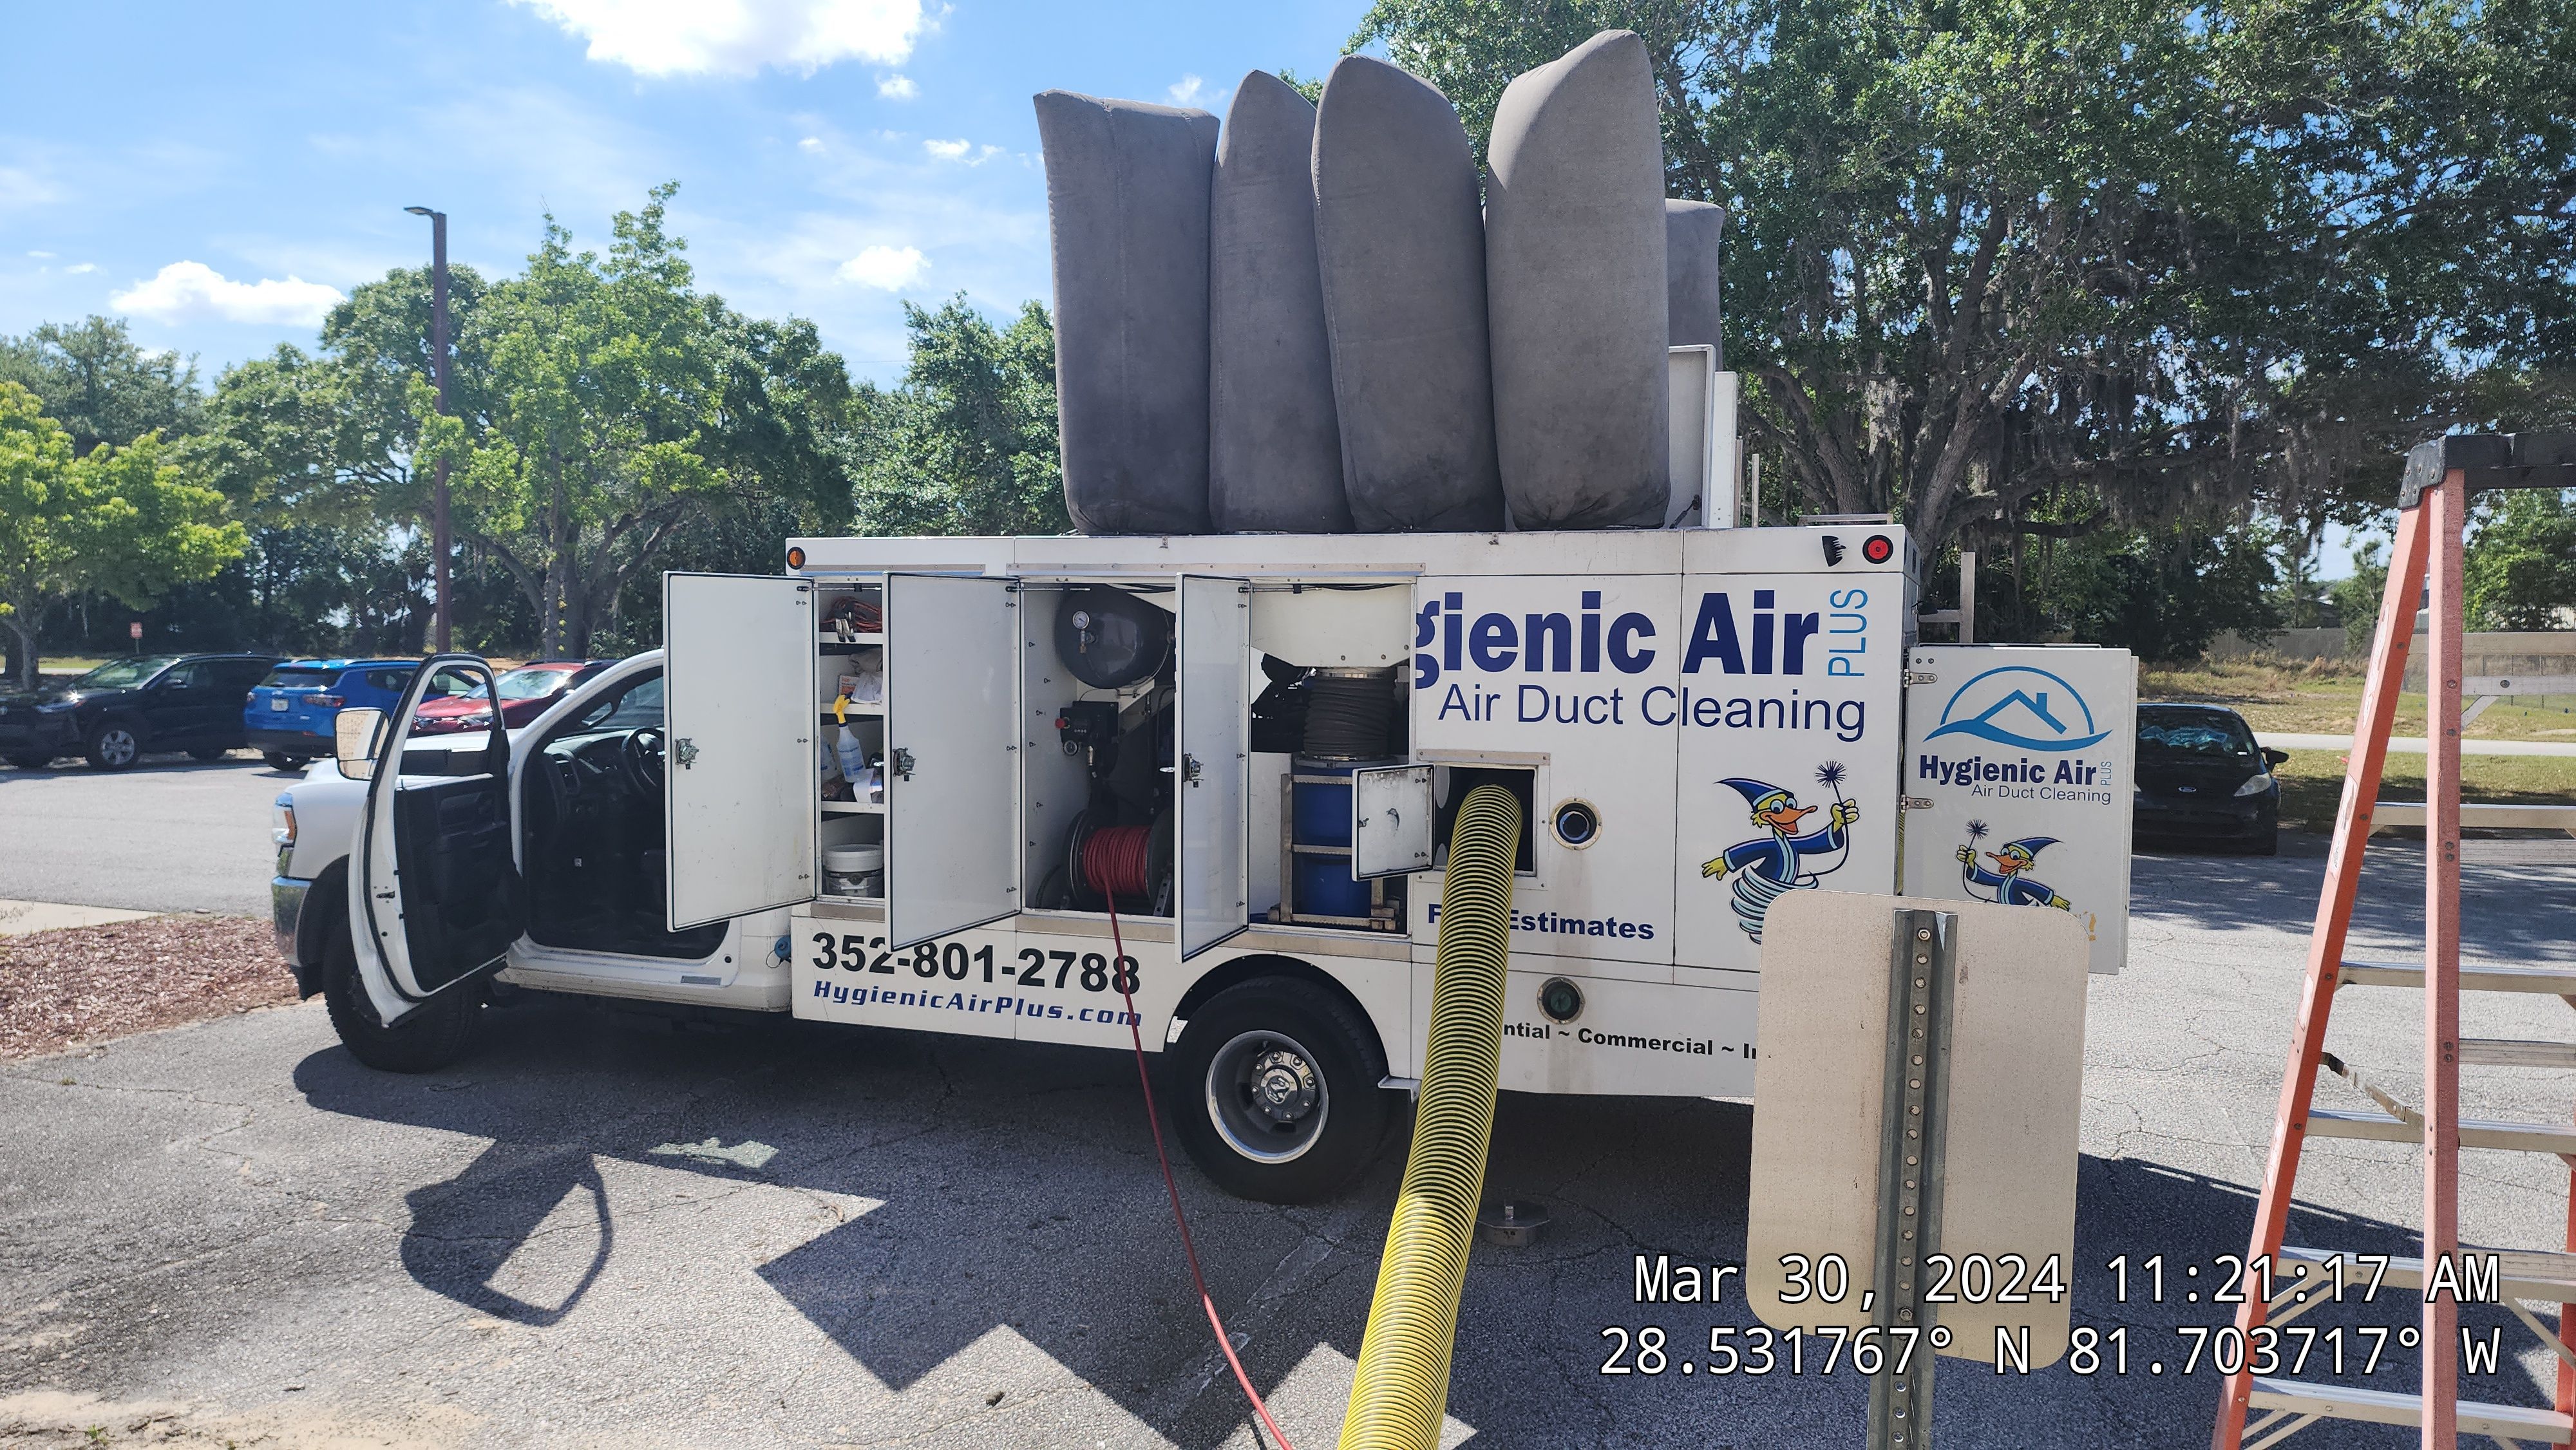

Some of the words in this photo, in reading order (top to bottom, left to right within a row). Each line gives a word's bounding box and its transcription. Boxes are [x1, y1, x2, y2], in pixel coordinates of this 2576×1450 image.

[1681, 590, 1819, 675] Air
[1828, 588, 1868, 677] PLUS
[1439, 684, 1501, 722] Air
[1517, 684, 1624, 725] Duct
[1641, 686, 1865, 742] Cleaning
[1919, 755, 2045, 786] Hygienic
[2053, 759, 2097, 785] Air
[2100, 761, 2112, 786] PLUS
[1971, 784, 1993, 797] Air
[1998, 785, 2034, 799] Duct
[2040, 787, 2111, 805] Cleaning
[1510, 909, 1654, 939] Estimates
[812, 932, 1141, 995] 352-801-2788
[813, 980, 1142, 1026] HygienicAirPlus.com
[1578, 1028, 1713, 1055] Commercial
